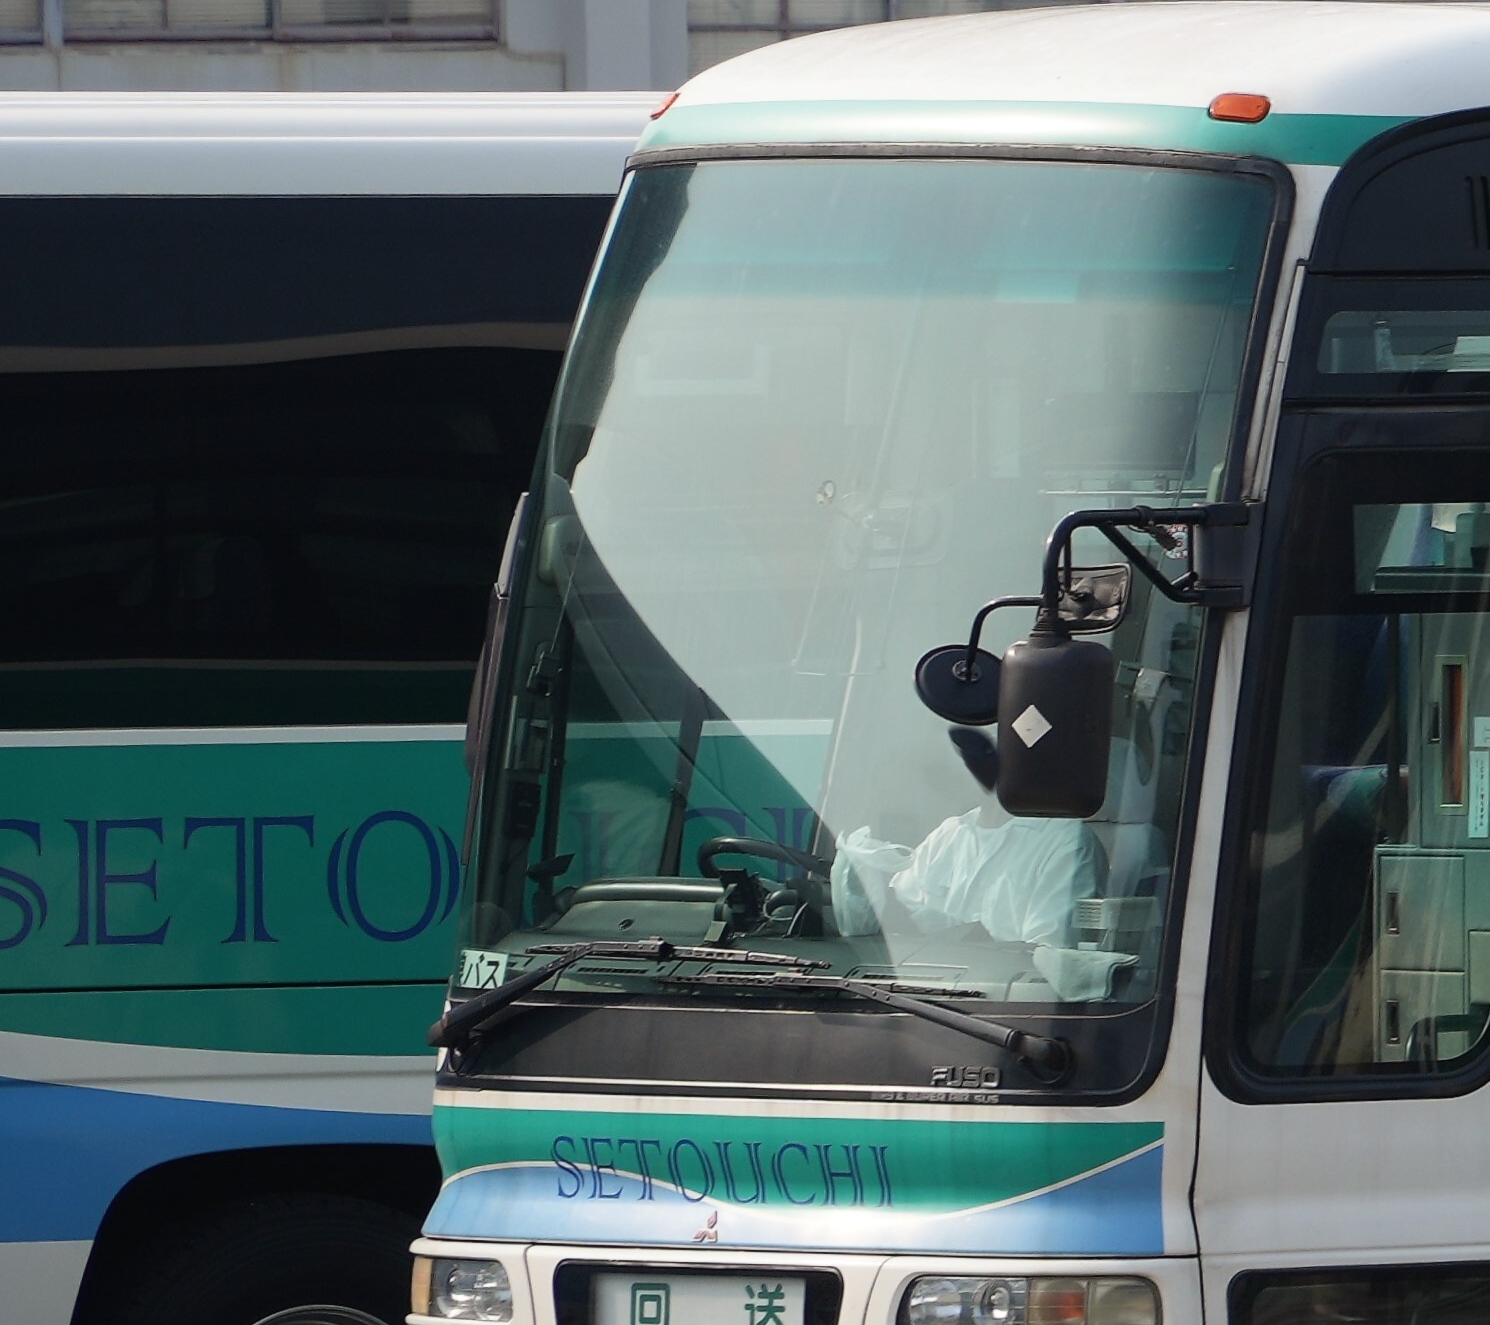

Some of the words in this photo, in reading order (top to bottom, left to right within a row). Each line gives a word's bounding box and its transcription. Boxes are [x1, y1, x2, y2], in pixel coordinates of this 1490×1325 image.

[0, 808, 815, 951] SETO
[460, 952, 501, 989] バス
[929, 1064, 1000, 1088] FUSO
[550, 1135, 894, 1208] SETOUCHI
